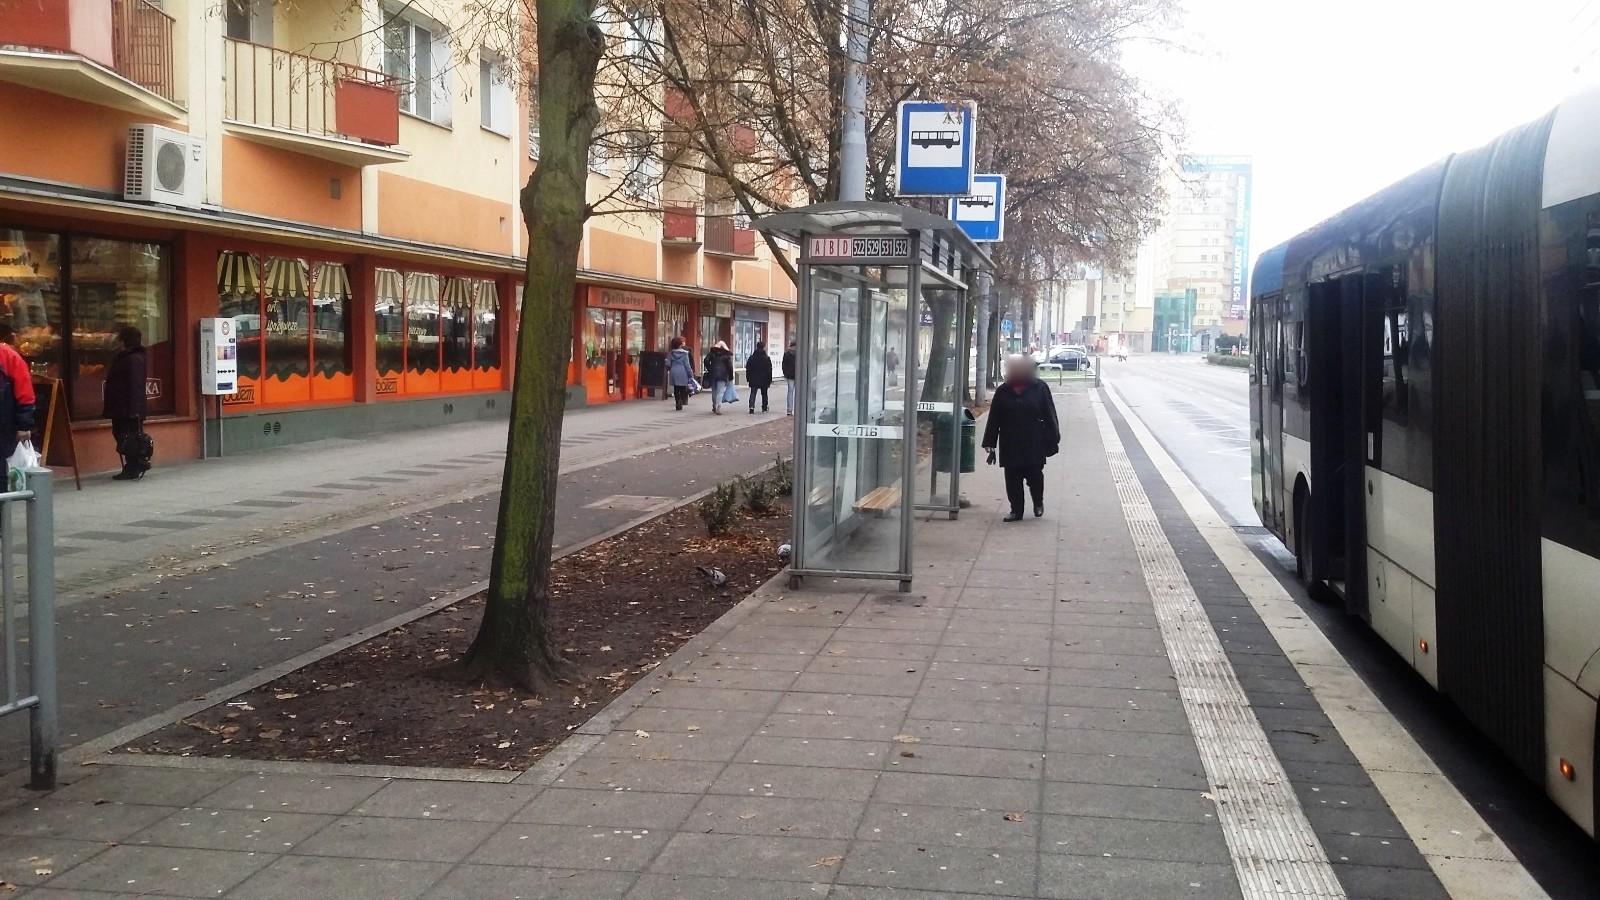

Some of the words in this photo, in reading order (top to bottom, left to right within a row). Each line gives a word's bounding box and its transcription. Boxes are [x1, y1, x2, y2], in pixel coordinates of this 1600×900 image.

[815, 240, 820, 254] A
[829, 240, 834, 255] B
[843, 240, 848, 254] D
[853, 240, 865, 255] 522
[867, 240, 879, 255] 529
[881, 240, 893, 255] 531
[895, 240, 907, 254] 532
